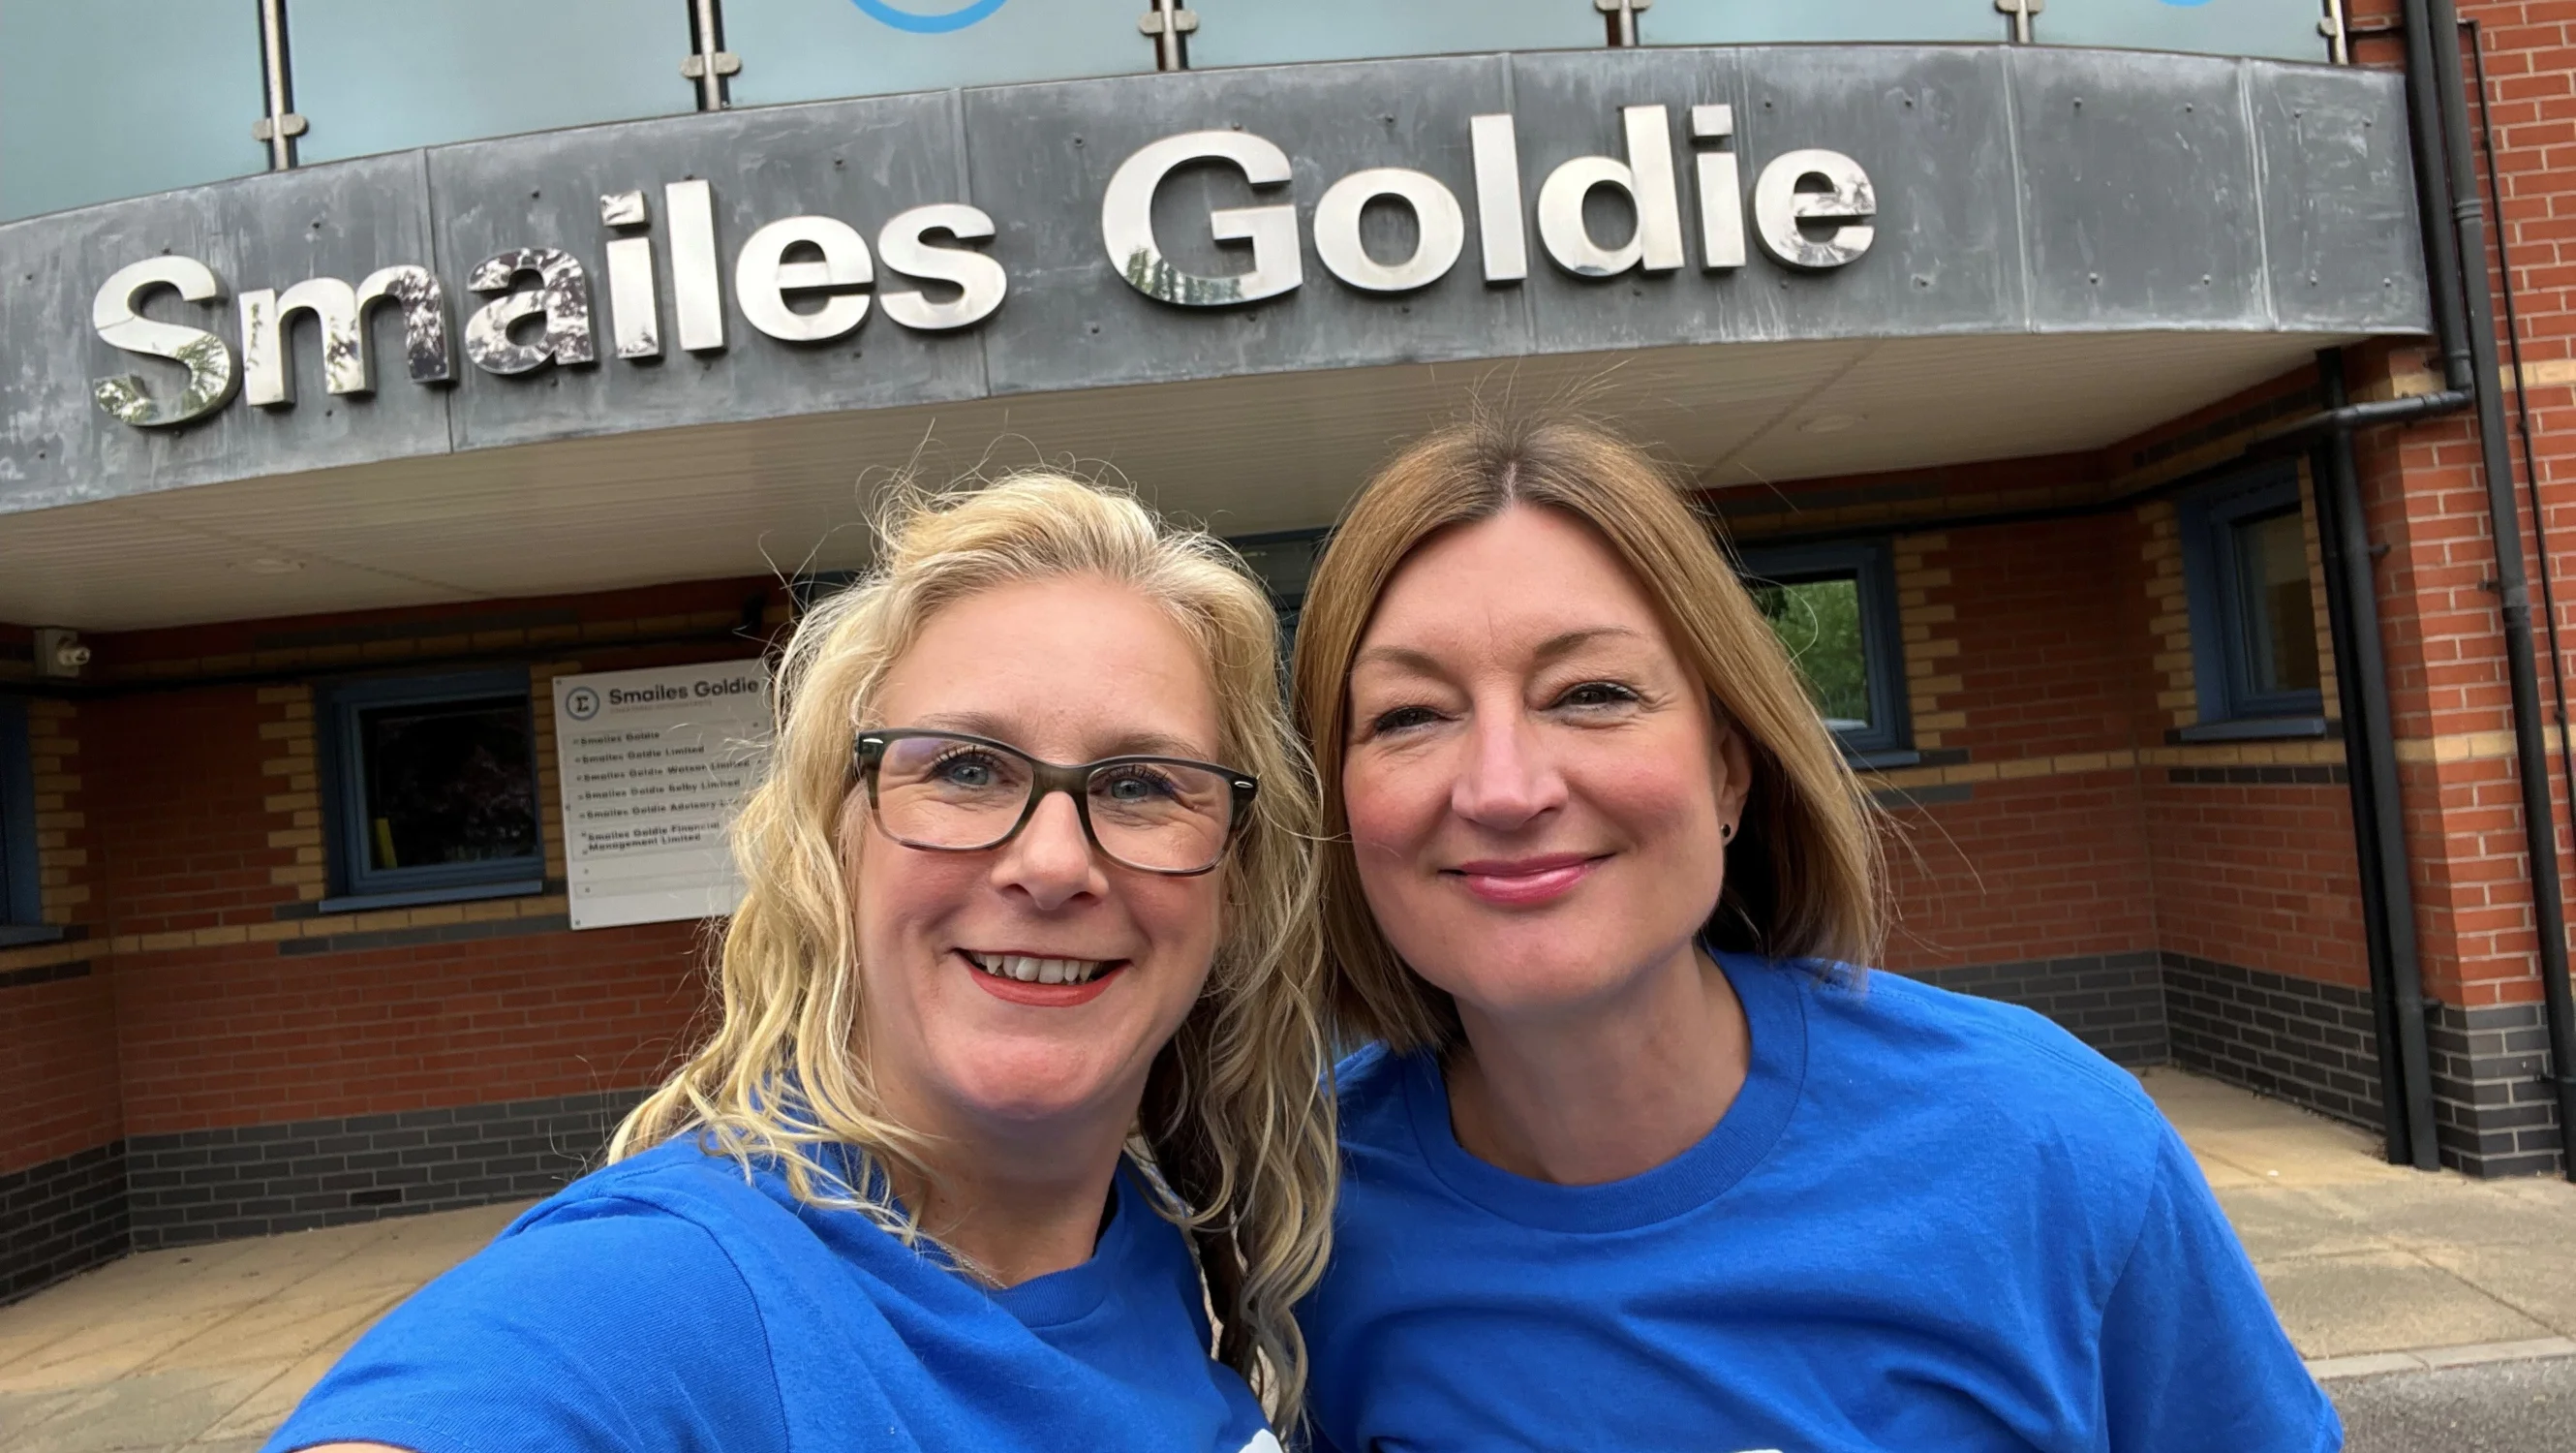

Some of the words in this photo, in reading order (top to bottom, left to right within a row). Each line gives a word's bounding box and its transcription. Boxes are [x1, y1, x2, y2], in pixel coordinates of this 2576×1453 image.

[93, 179, 1009, 429] Smailes
[1101, 104, 1877, 309] Goldie
[609, 684, 689, 705] Smailes
[694, 676, 758, 697] Goldie
[665, 746, 705, 757] Limited
[700, 778, 741, 790] Limited
[589, 837, 659, 851] Management
[661, 833, 701, 846] Limited
